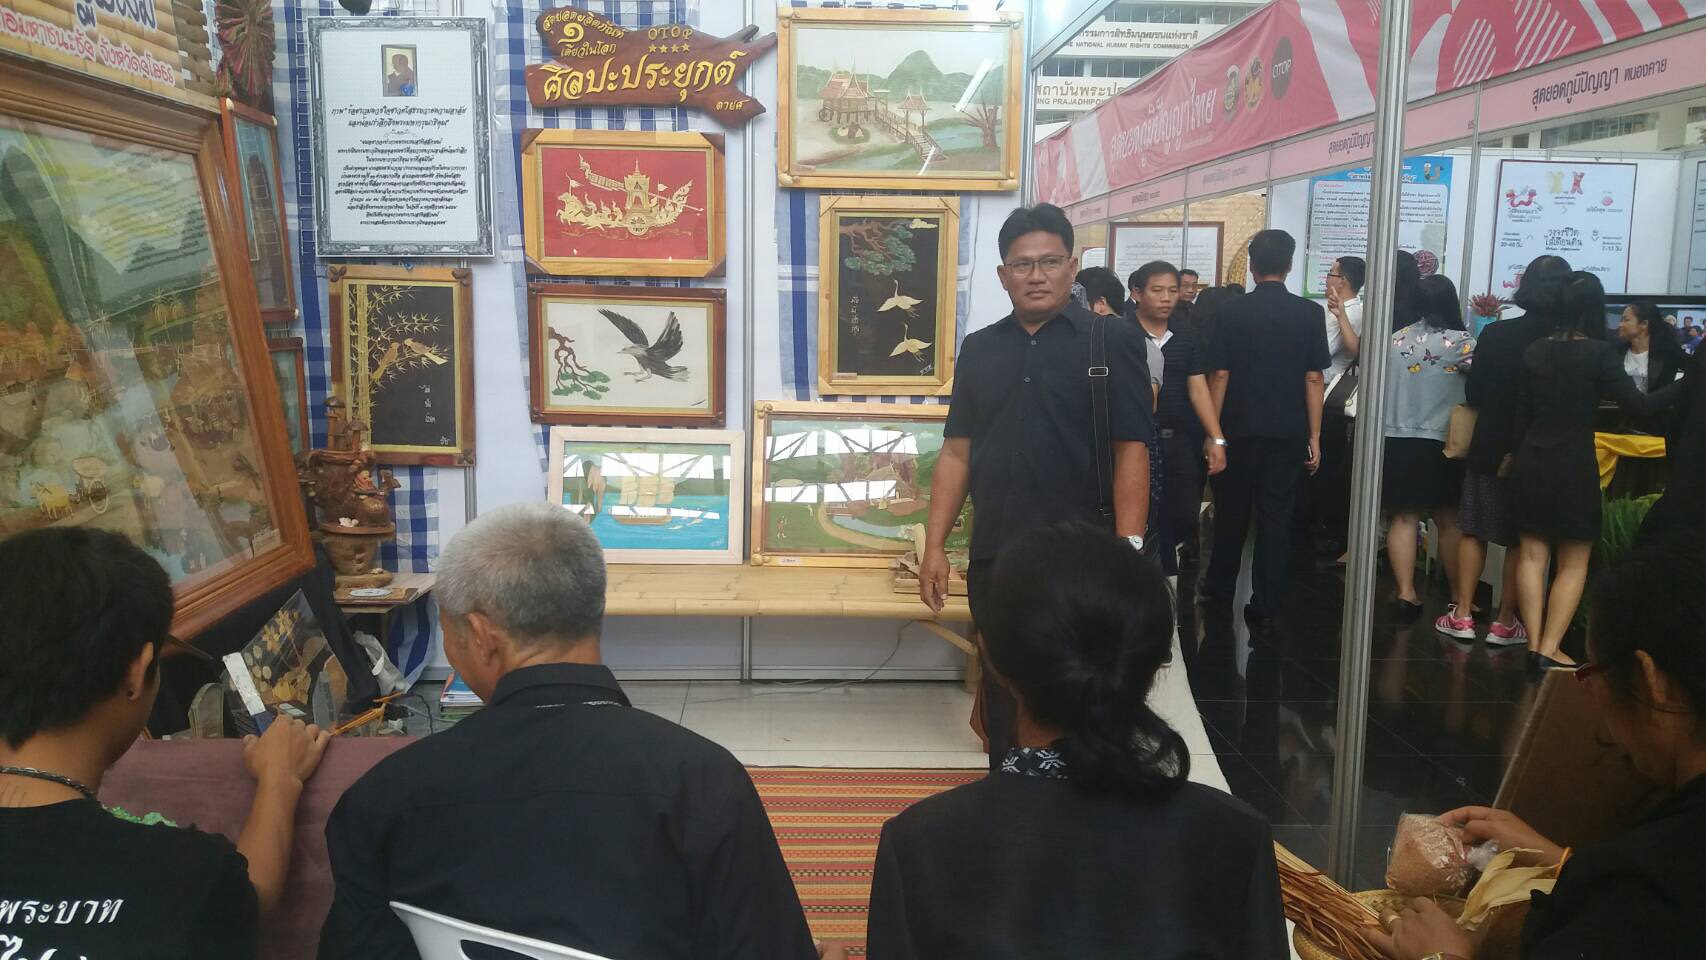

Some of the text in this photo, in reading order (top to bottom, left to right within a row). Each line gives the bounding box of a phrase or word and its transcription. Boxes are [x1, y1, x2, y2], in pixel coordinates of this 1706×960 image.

[648, 28, 694, 41] OTOP
[561, 41, 617, 58] เดียวในโลก
[539, 50, 748, 102] ศิลปะประยุกต์
[1272, 58, 1292, 79] OTOP
[1532, 58, 1667, 112] สุดยอดภูมิปัญญา หนองคาย
[0, 899, 124, 924] พระบาท
